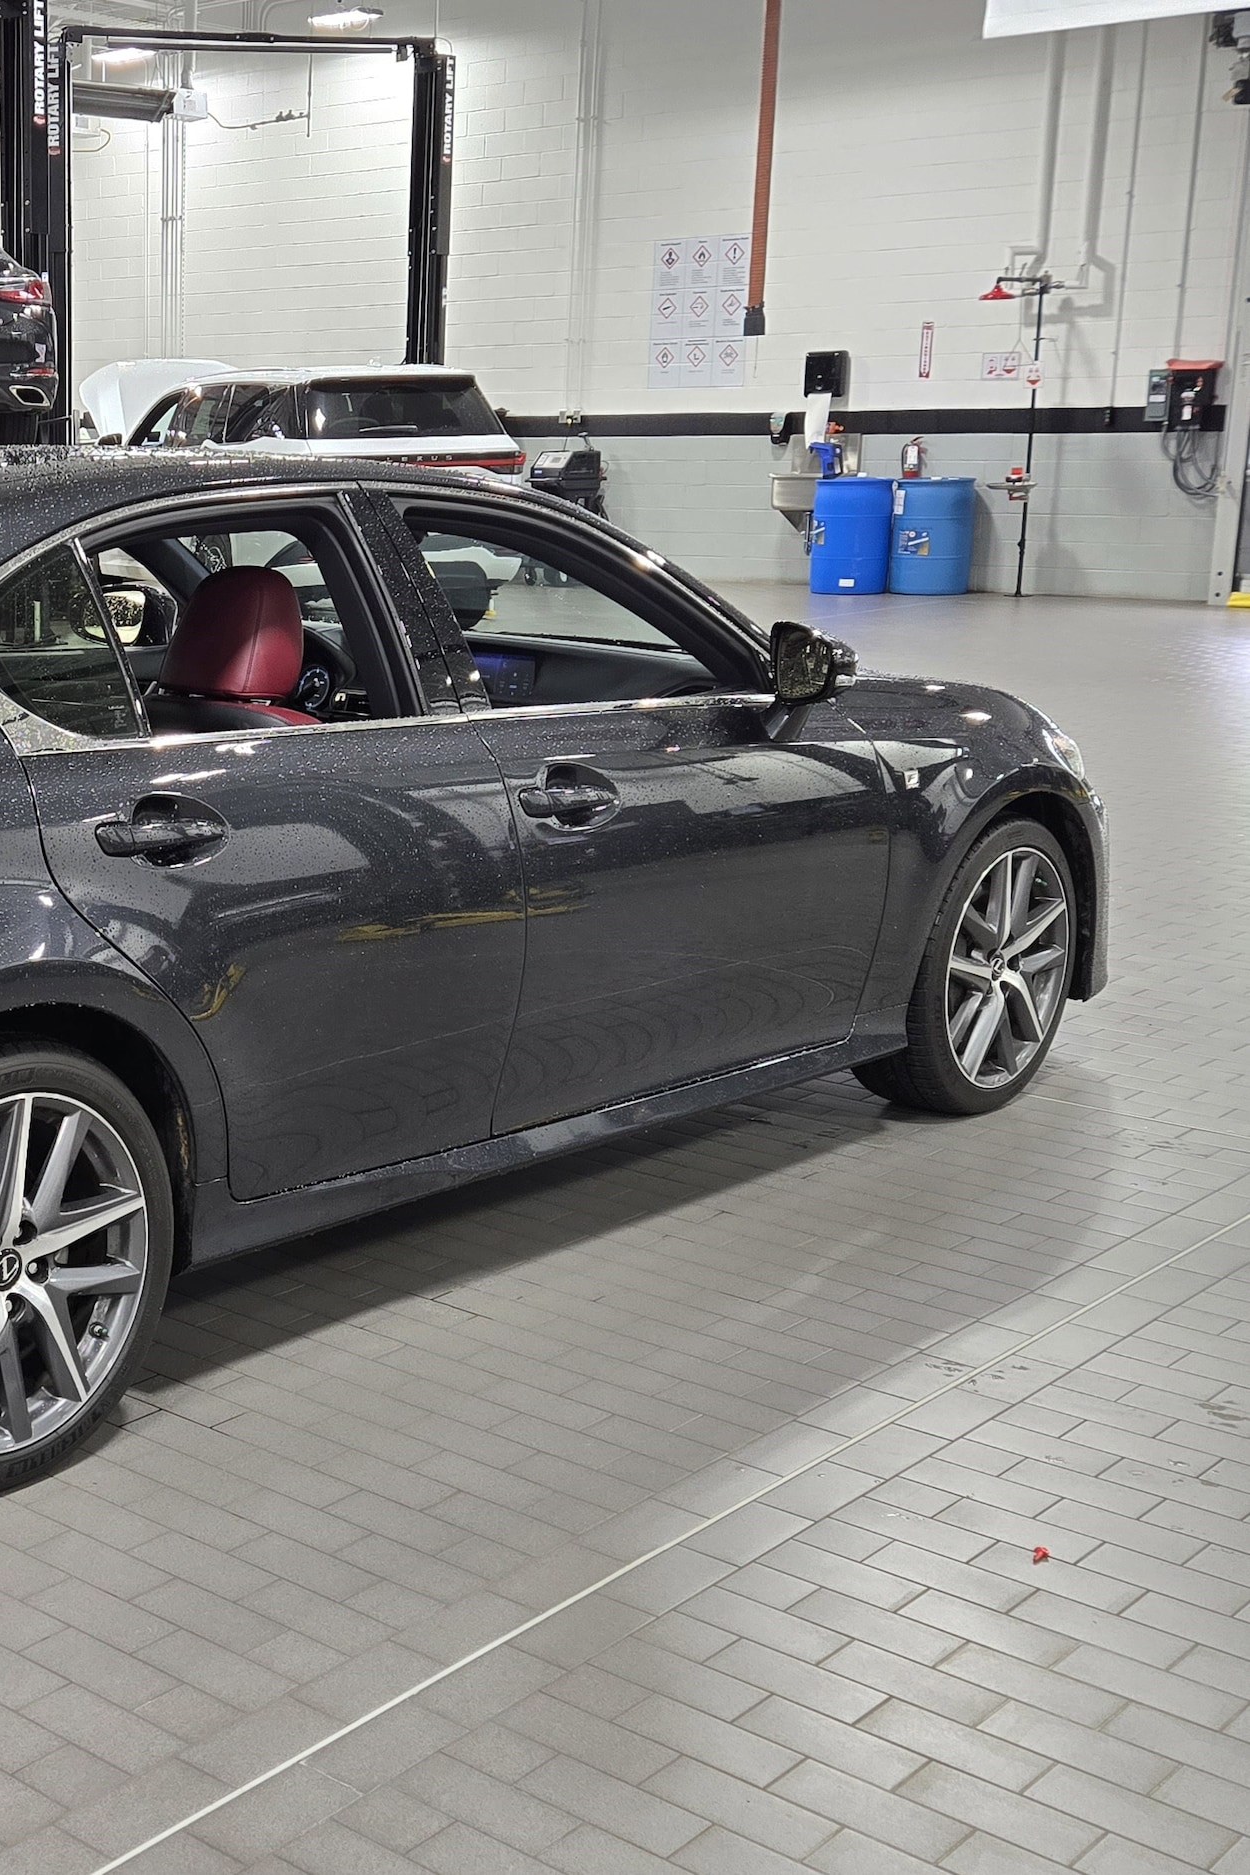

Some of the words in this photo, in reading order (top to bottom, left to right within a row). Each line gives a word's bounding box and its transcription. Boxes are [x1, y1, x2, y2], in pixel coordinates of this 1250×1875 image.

[33, 0, 45, 38] LIFT
[34, 41, 45, 115] ROTARY
[47, 44, 59, 79] LIFT
[445, 56, 454, 89] LIFT
[47, 82, 60, 147] ROTARY
[443, 92, 453, 154] ROTARY
[386, 455, 453, 463] LEXUS
